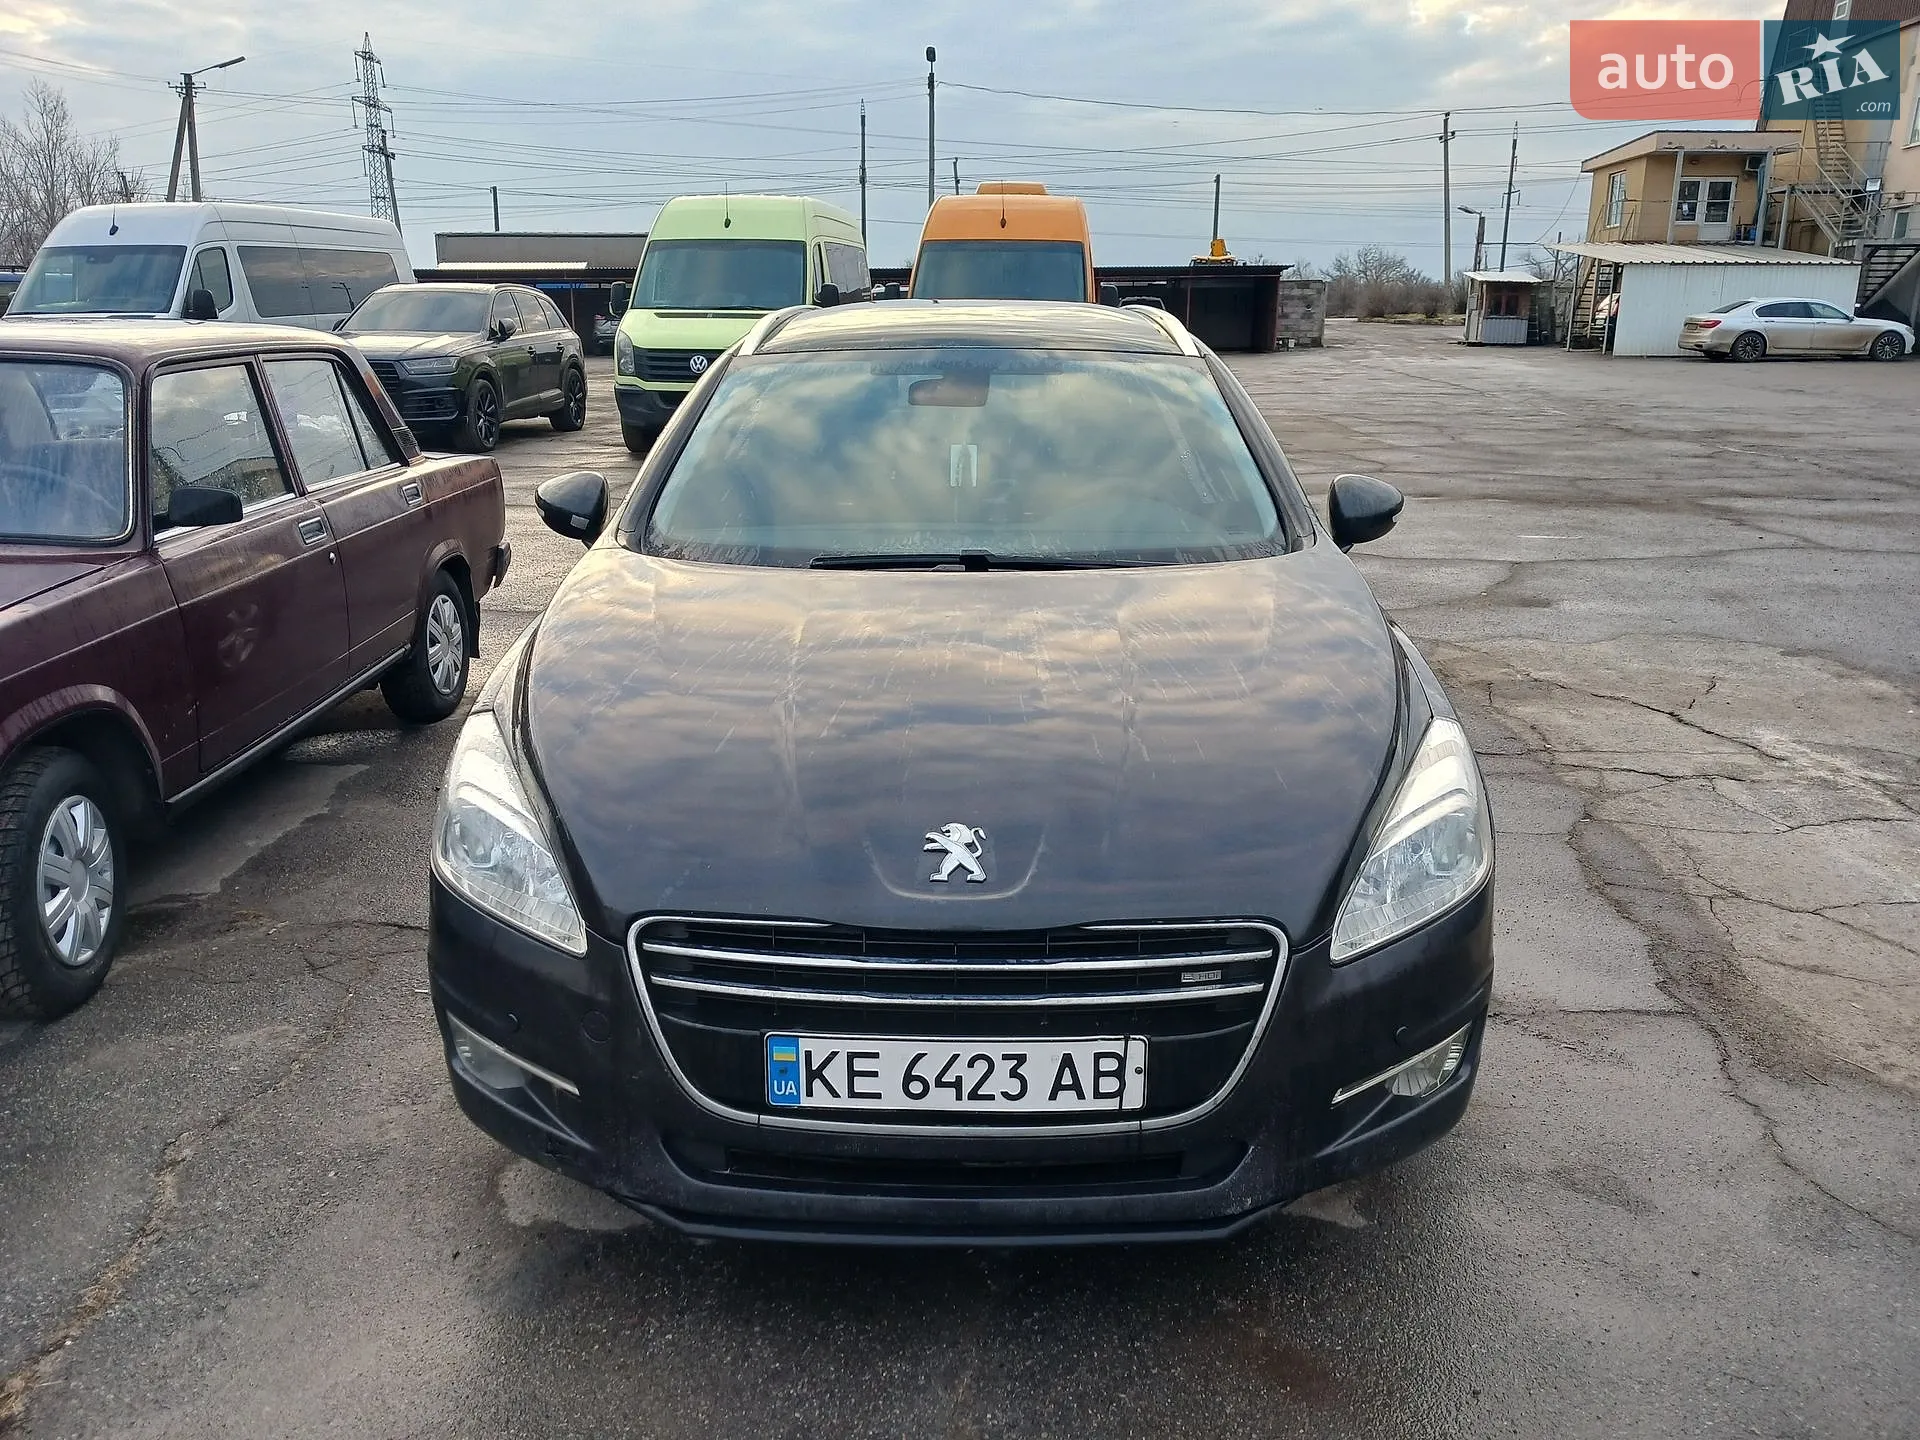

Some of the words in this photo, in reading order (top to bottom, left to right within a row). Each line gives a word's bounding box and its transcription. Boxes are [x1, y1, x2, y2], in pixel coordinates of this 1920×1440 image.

[773, 1079, 798, 1096] UA
[803, 1049, 883, 1099] KE
[900, 1051, 1029, 1102] 6423
[1047, 1051, 1127, 1101] AB
